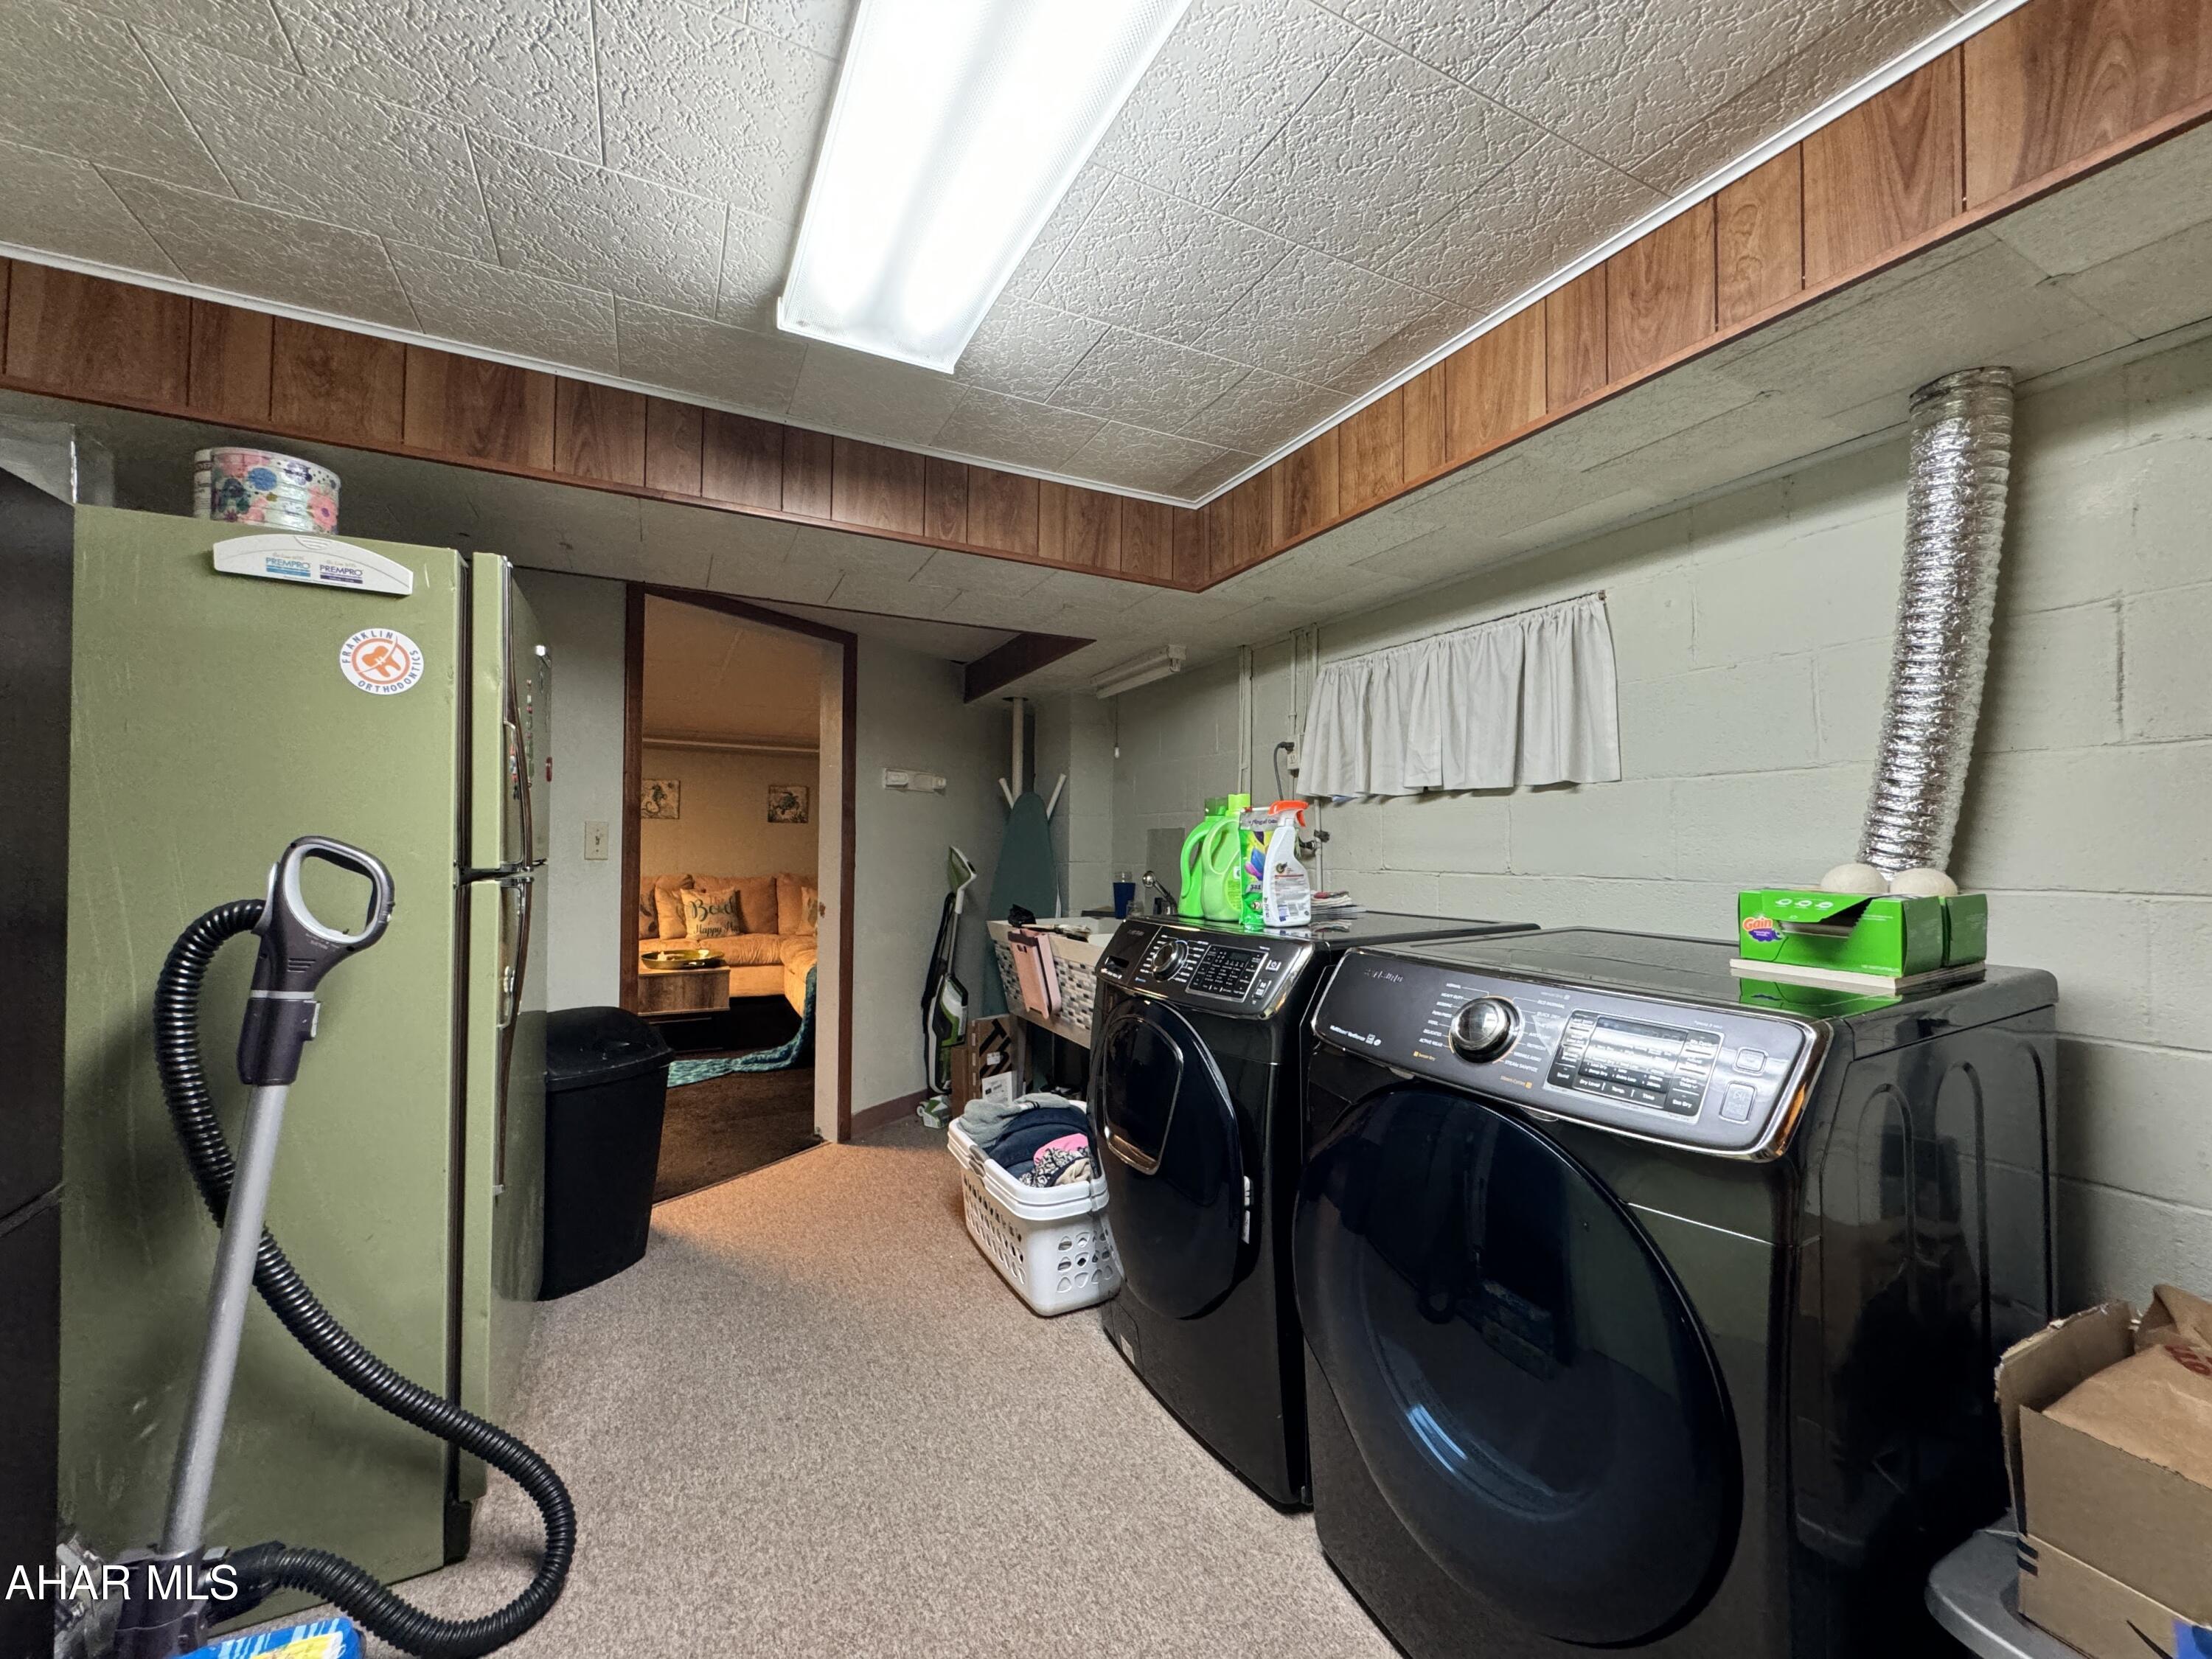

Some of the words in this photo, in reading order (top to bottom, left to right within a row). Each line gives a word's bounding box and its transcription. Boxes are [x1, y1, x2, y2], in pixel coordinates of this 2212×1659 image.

[265, 557, 310, 569] PREMPRO
[319, 564, 364, 577] PREMPRO
[342, 630, 393, 664] FRANKLIN
[358, 650, 421, 693] ORTHODONTICS
[1742, 917, 1773, 931] Gain
